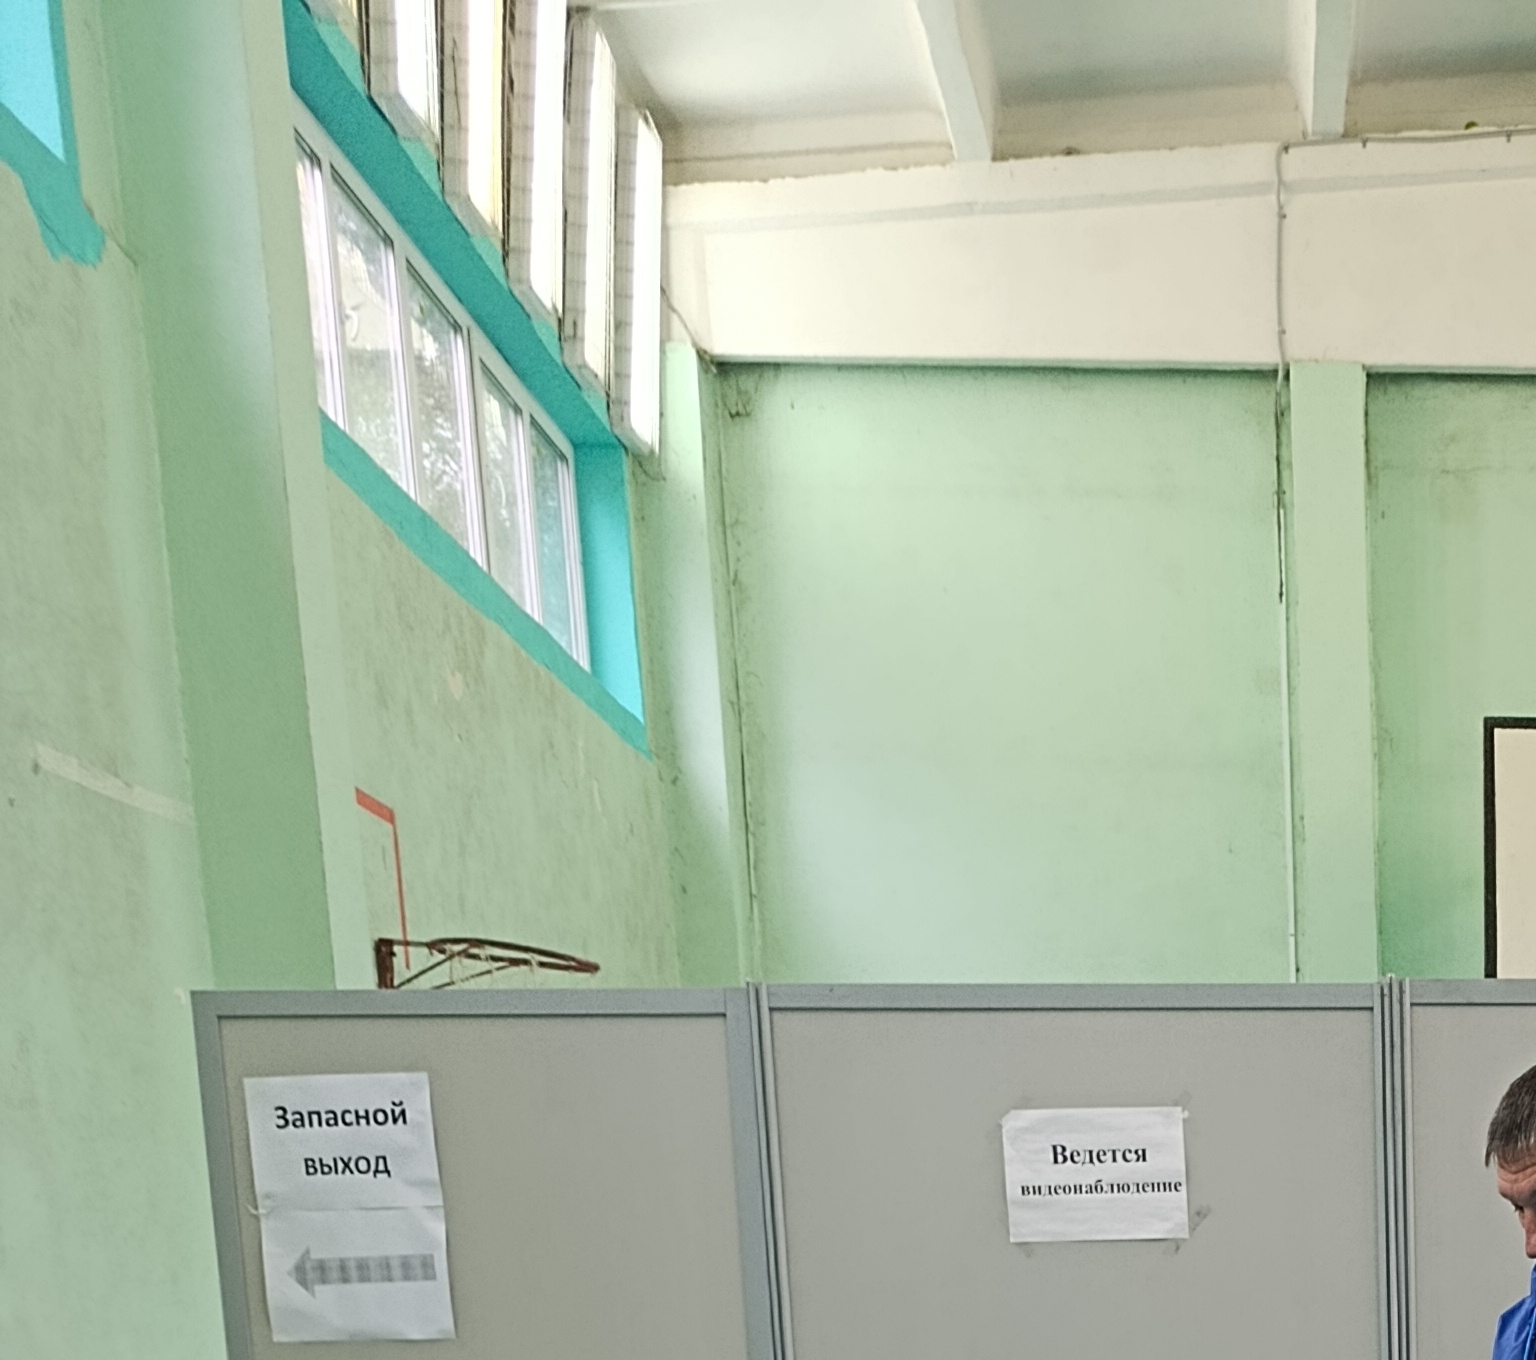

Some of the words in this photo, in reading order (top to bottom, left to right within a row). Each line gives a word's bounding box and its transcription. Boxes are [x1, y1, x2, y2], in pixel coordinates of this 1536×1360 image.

[273, 1100, 408, 1129] Запасной
[303, 1155, 392, 1178] выход
[1051, 1143, 1148, 1167] Ведется
[1020, 1179, 1183, 1197] видеонаблюдение
